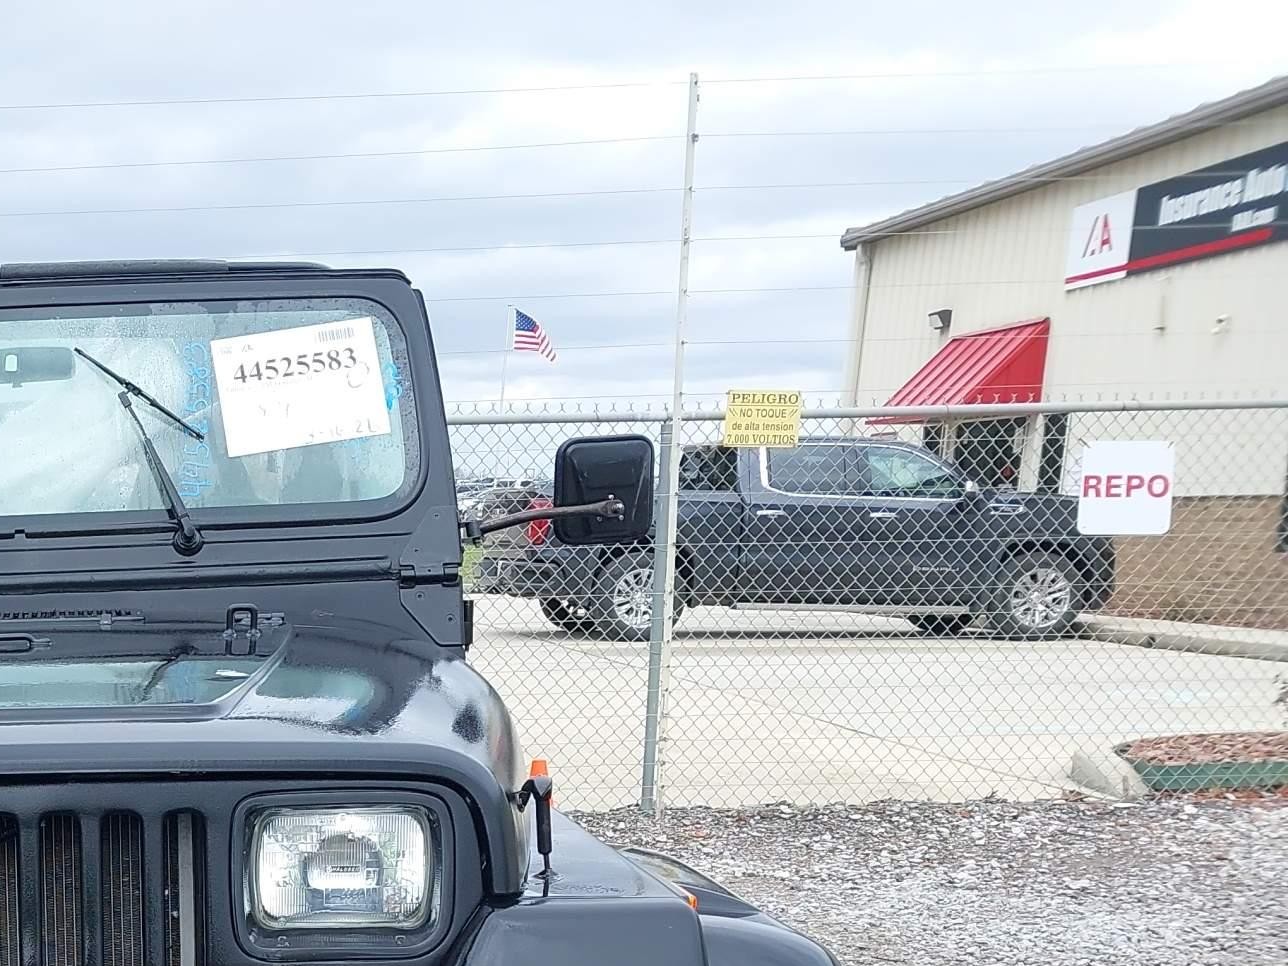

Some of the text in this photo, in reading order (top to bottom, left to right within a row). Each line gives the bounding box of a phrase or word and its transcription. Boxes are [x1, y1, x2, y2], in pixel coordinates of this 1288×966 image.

[233, 347, 358, 384] 44525583
[731, 393, 799, 405] PELIGRO
[739, 408, 787, 418] NO TOQUE
[732, 421, 794, 431] de alta tension
[752, 434, 796, 444] VOLTIOS
[1082, 474, 1170, 498] REPO
